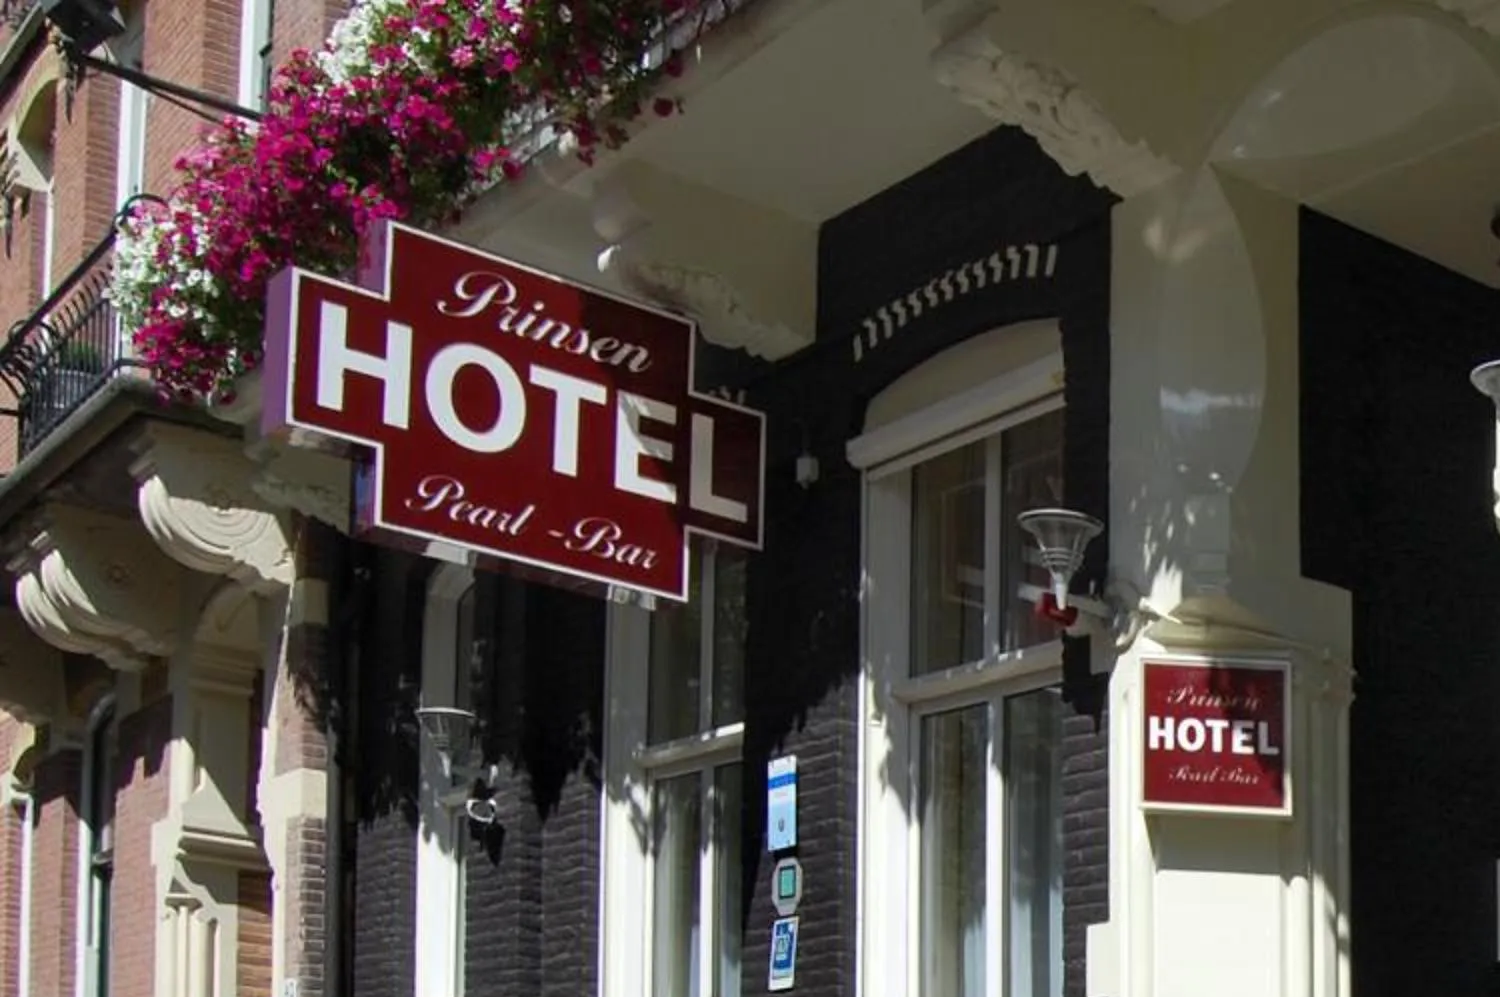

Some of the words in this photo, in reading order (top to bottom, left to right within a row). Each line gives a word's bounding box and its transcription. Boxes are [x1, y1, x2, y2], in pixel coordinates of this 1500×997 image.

[438, 271, 654, 373] Prinsen
[317, 300, 748, 523] HOTEL
[404, 474, 536, 536] Pearl
[1149, 716, 1279, 755] HOTEL
